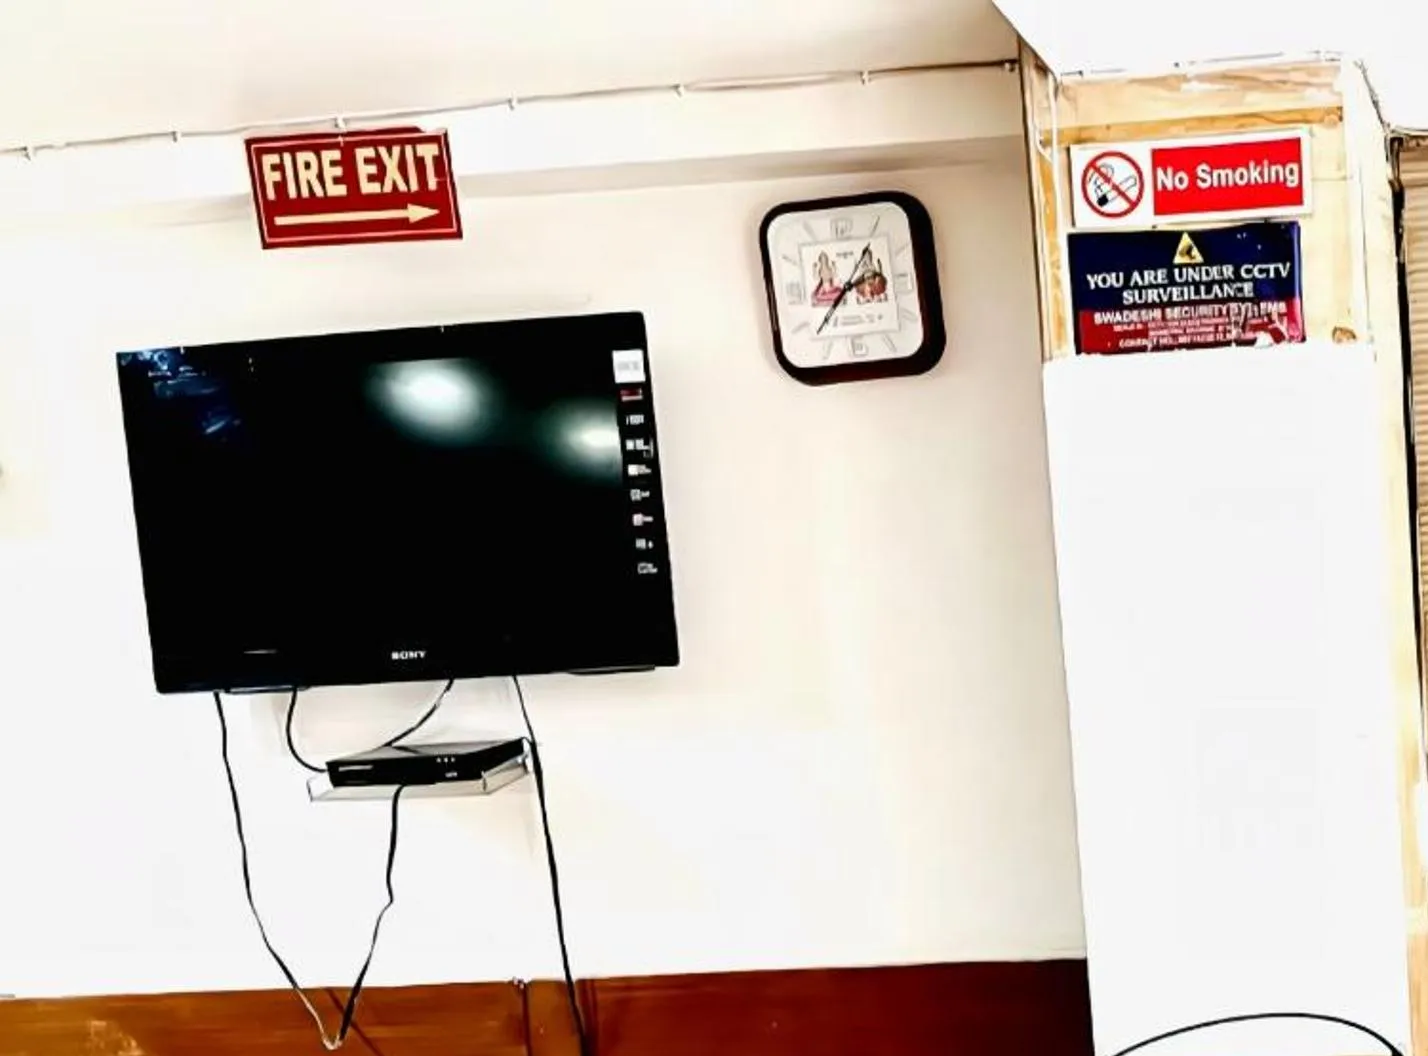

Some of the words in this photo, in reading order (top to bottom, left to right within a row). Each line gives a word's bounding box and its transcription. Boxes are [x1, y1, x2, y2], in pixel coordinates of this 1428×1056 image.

[262, 149, 347, 200] FIRE
[354, 143, 439, 195] EXIT
[1157, 166, 1189, 192] No
[1196, 159, 1299, 189] Smoking
[1086, 271, 1124, 289] YOU
[1130, 269, 1169, 287] ARE
[1173, 264, 1234, 283] UNDER
[1240, 262, 1290, 280] CCTV
[1122, 282, 1254, 305] SURVEILLANCE
[391, 650, 427, 660] SONY
